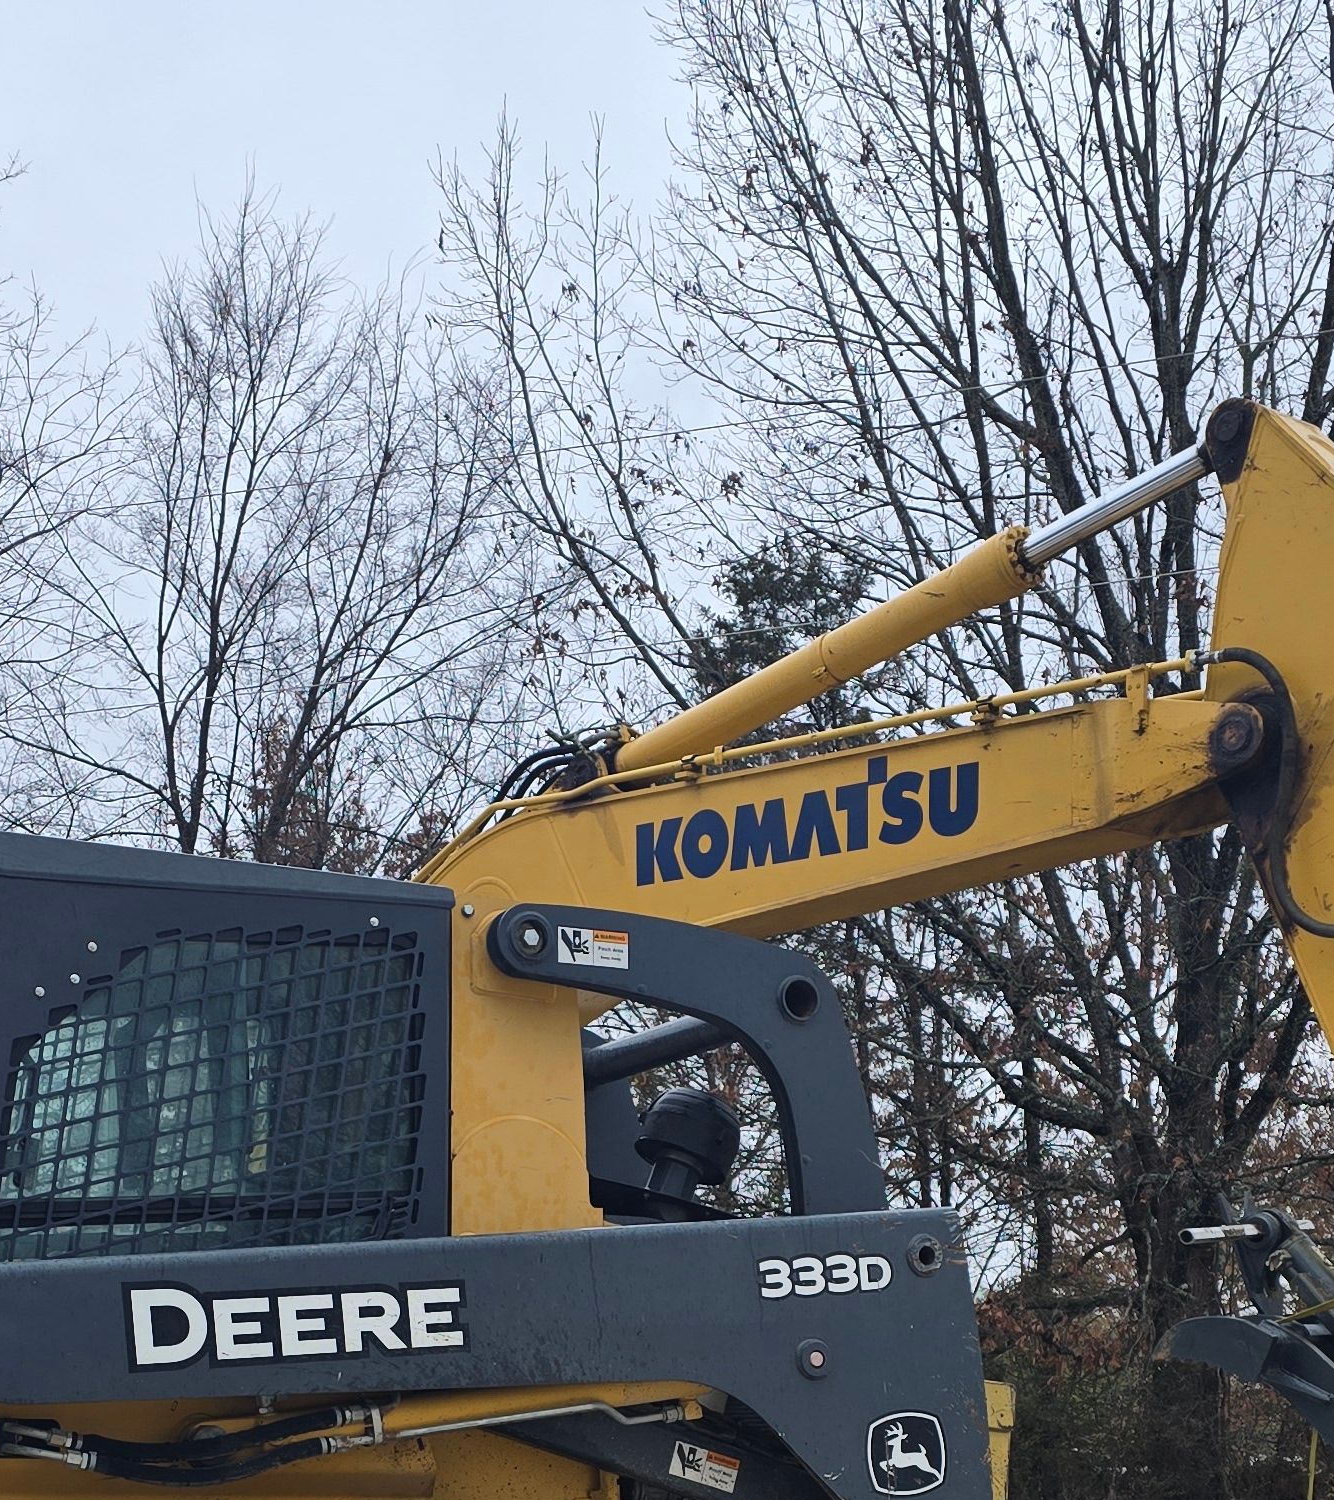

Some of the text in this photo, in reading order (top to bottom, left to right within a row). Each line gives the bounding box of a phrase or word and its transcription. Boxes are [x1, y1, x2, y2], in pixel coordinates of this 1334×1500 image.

[635, 755, 980, 887] KOMATSU
[758, 1254, 892, 1299] 333D
[130, 1287, 465, 1366] DEERE
